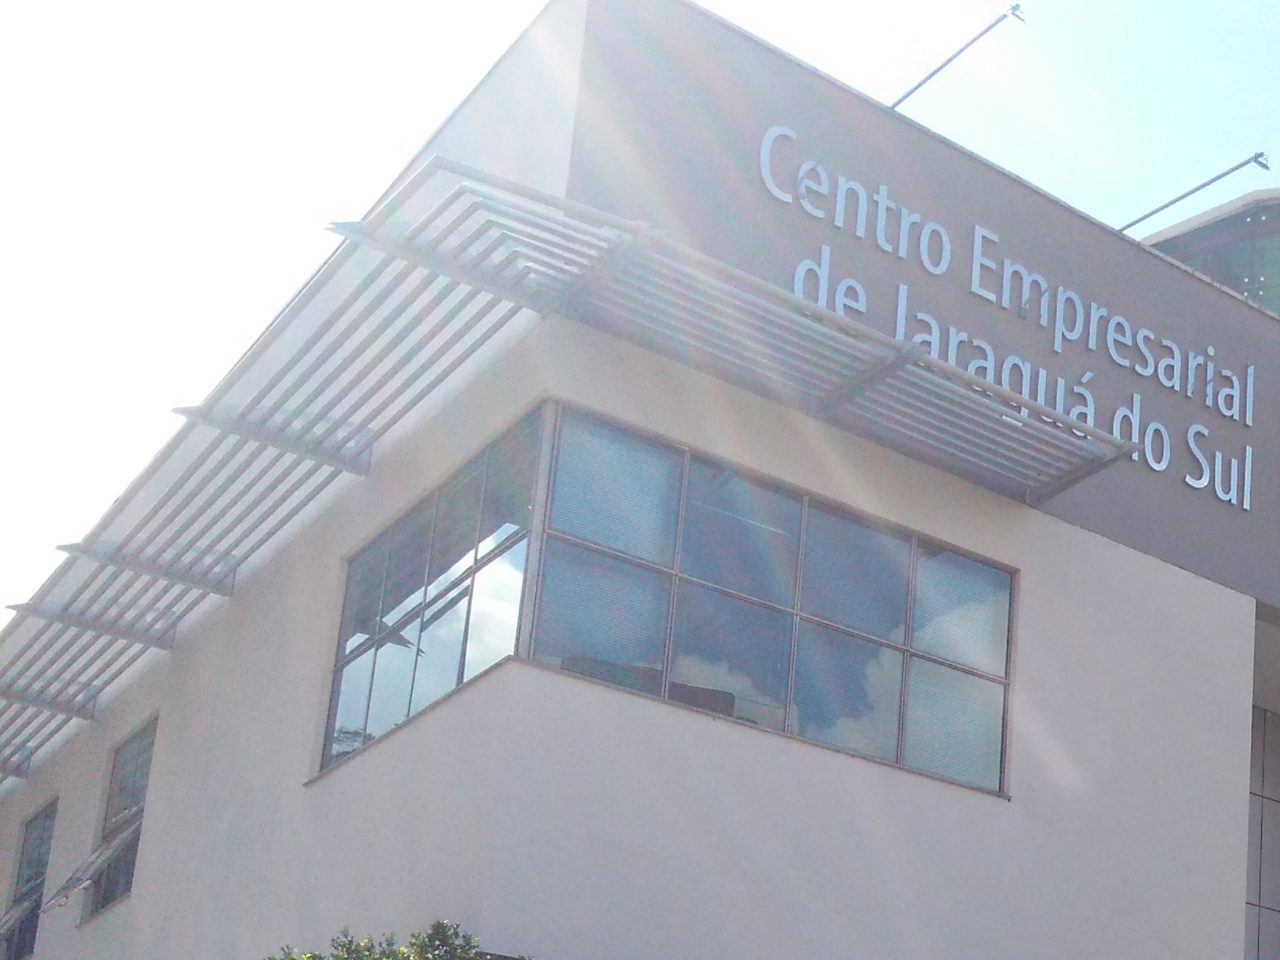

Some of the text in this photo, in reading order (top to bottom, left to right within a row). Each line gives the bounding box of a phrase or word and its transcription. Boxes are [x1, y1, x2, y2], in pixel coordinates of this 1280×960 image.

[759, 125, 1255, 428] Centro Empresarial
[793, 243, 867, 318] de
[1112, 393, 1171, 472] do
[1185, 424, 1253, 511] Sul
